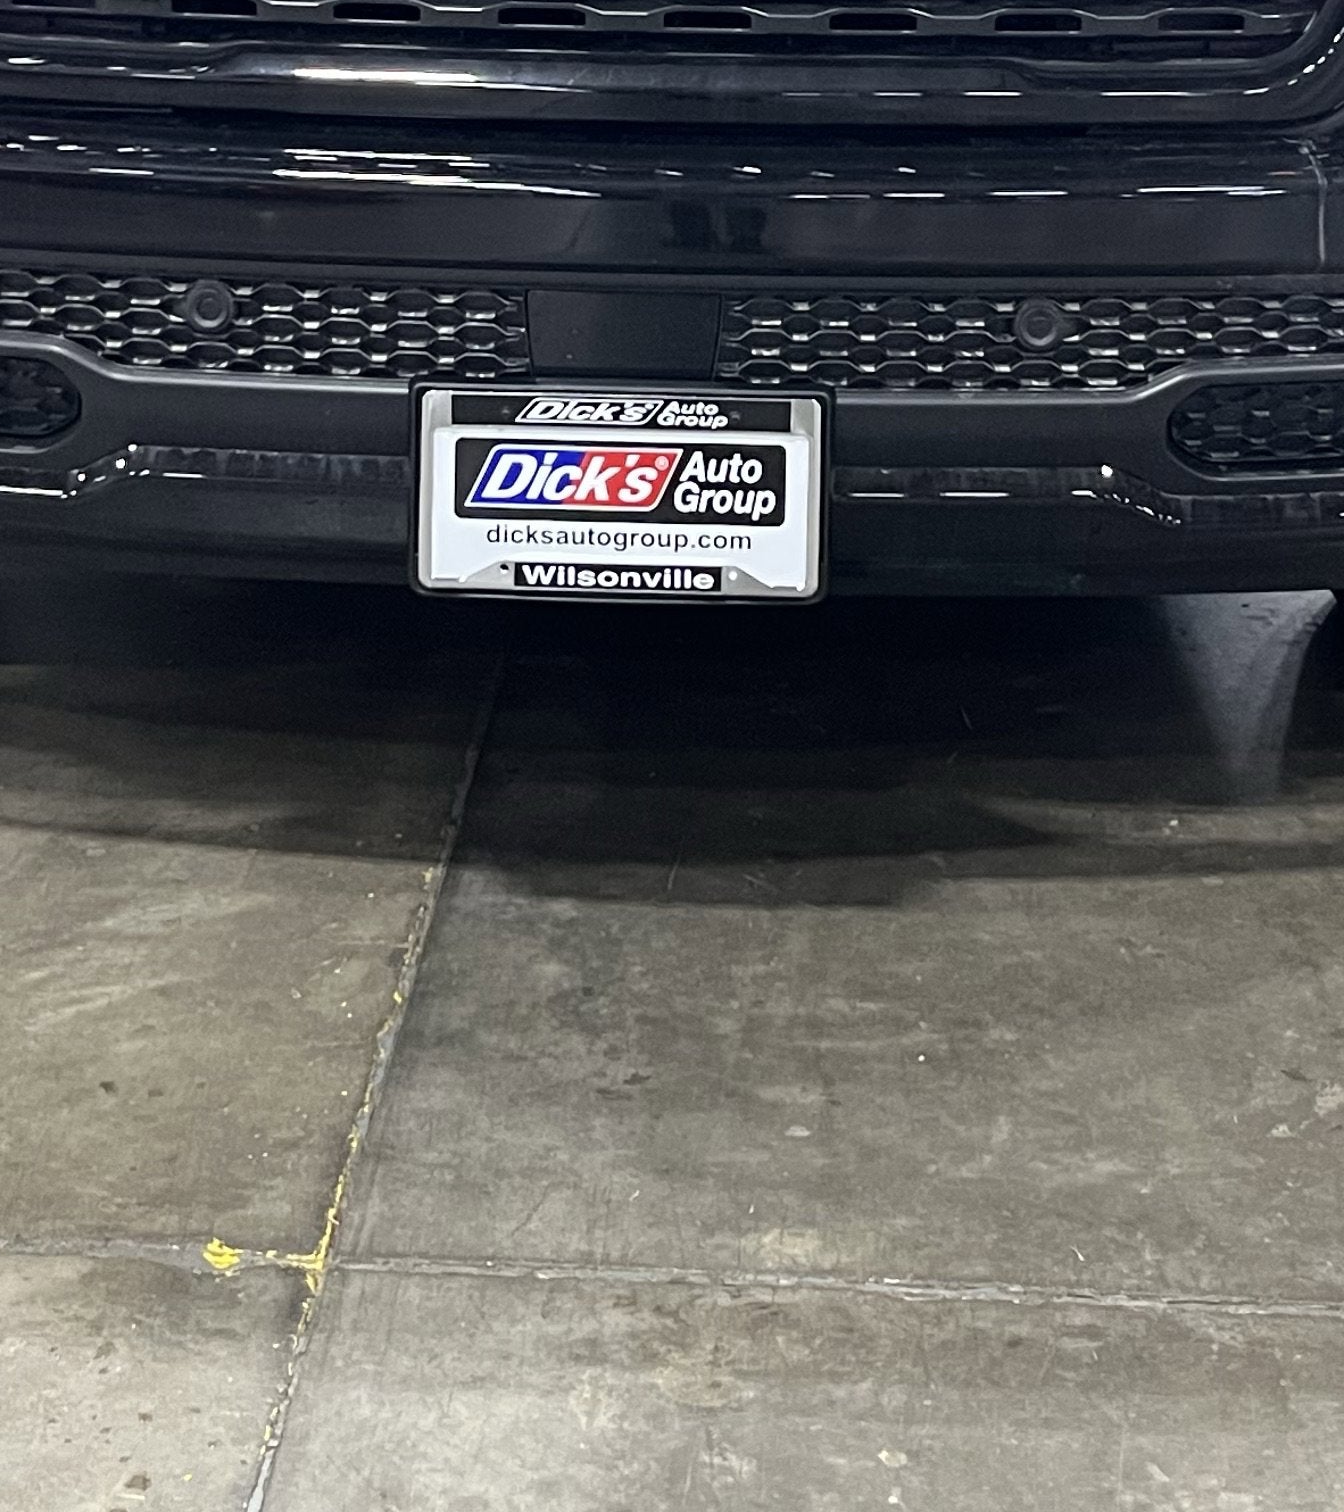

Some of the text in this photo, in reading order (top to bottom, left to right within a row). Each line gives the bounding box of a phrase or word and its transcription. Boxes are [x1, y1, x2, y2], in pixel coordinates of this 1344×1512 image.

[660, 401, 719, 416] Auto
[657, 414, 729, 430] Group
[679, 451, 763, 484] Auto
[673, 485, 777, 521] Group
[486, 524, 752, 551] dicksautogroup.com
[521, 564, 715, 590] Wilsonville
